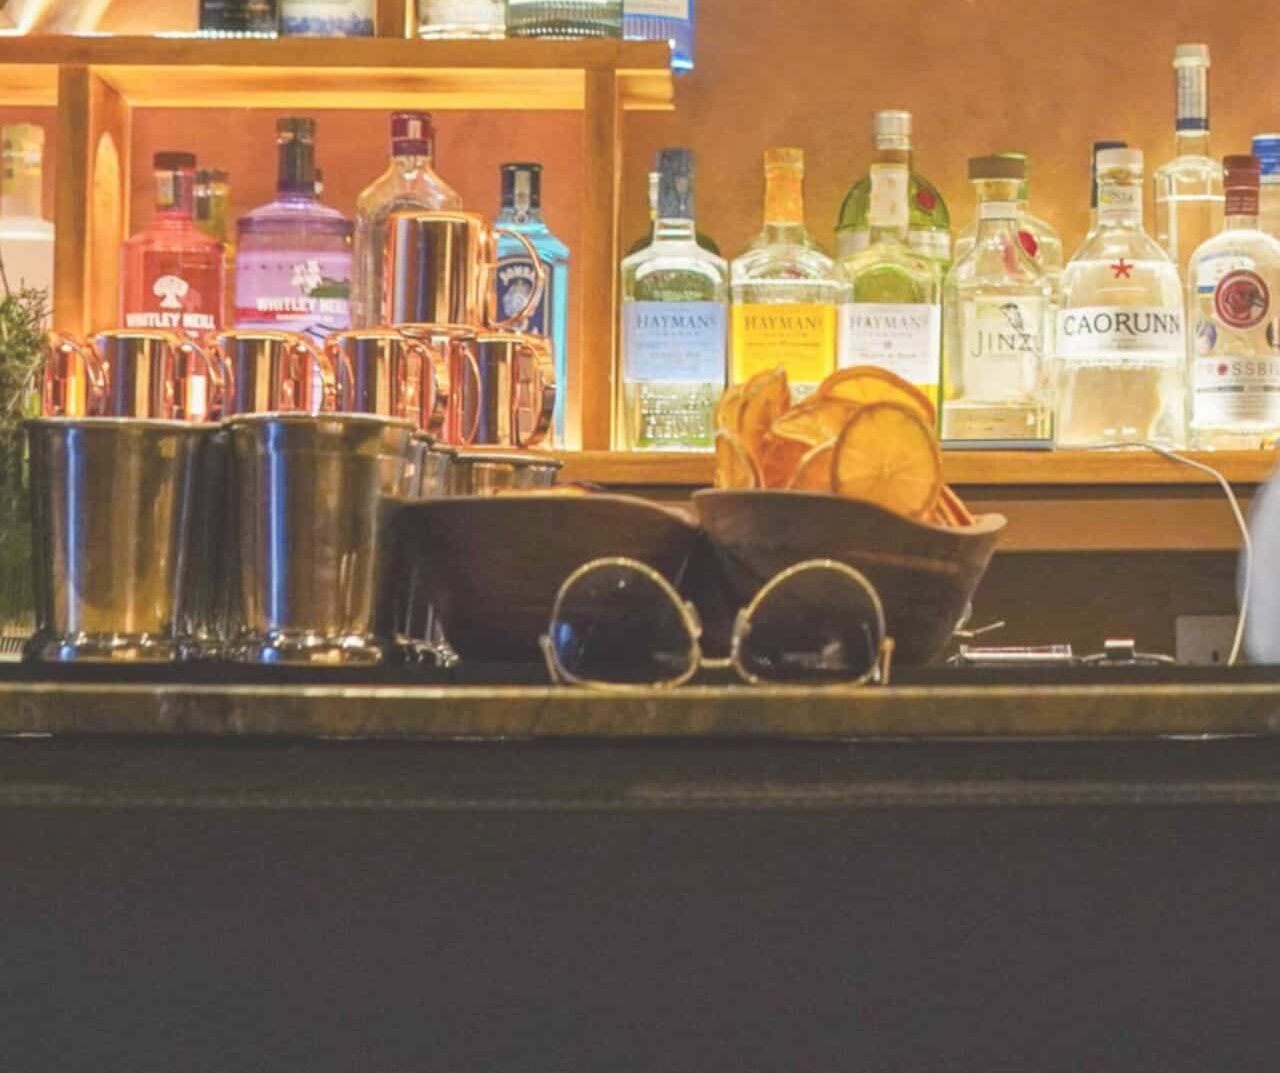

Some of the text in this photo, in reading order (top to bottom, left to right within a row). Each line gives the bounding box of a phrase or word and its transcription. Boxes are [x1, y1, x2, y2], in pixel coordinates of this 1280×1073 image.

[256, 296, 314, 312] WHITLEY
[126, 312, 181, 328] WHITLEY
[1063, 313, 1182, 337] CAORUNN
